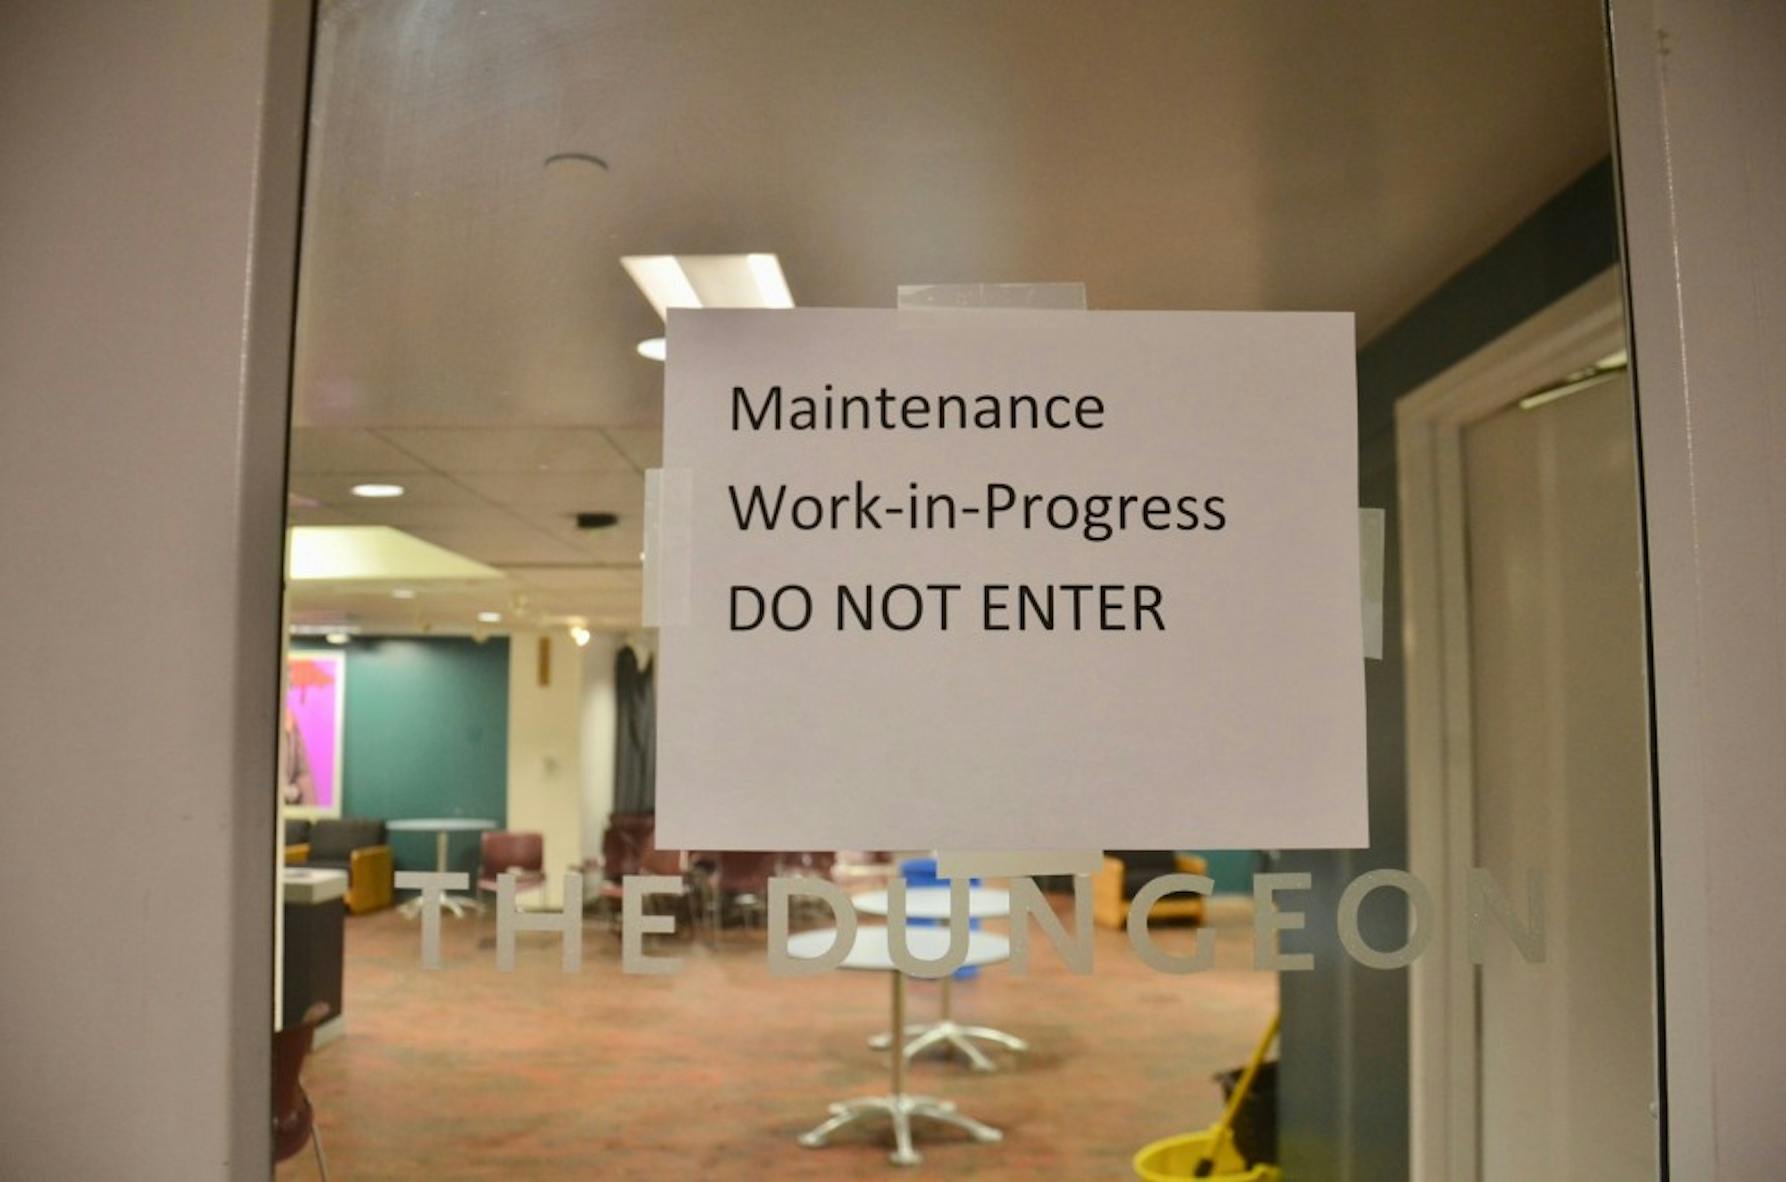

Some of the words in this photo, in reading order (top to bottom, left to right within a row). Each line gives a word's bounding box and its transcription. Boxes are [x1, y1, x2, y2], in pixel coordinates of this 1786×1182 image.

[729, 383, 1106, 432] Maintenance
[728, 480, 1227, 542] Work-in-Progress
[728, 583, 813, 633] DO
[836, 583, 962, 632] NOT
[982, 583, 1167, 632] ENTER
[395, 871, 686, 975] THE
[767, 867, 1547, 979] DUNGEON
